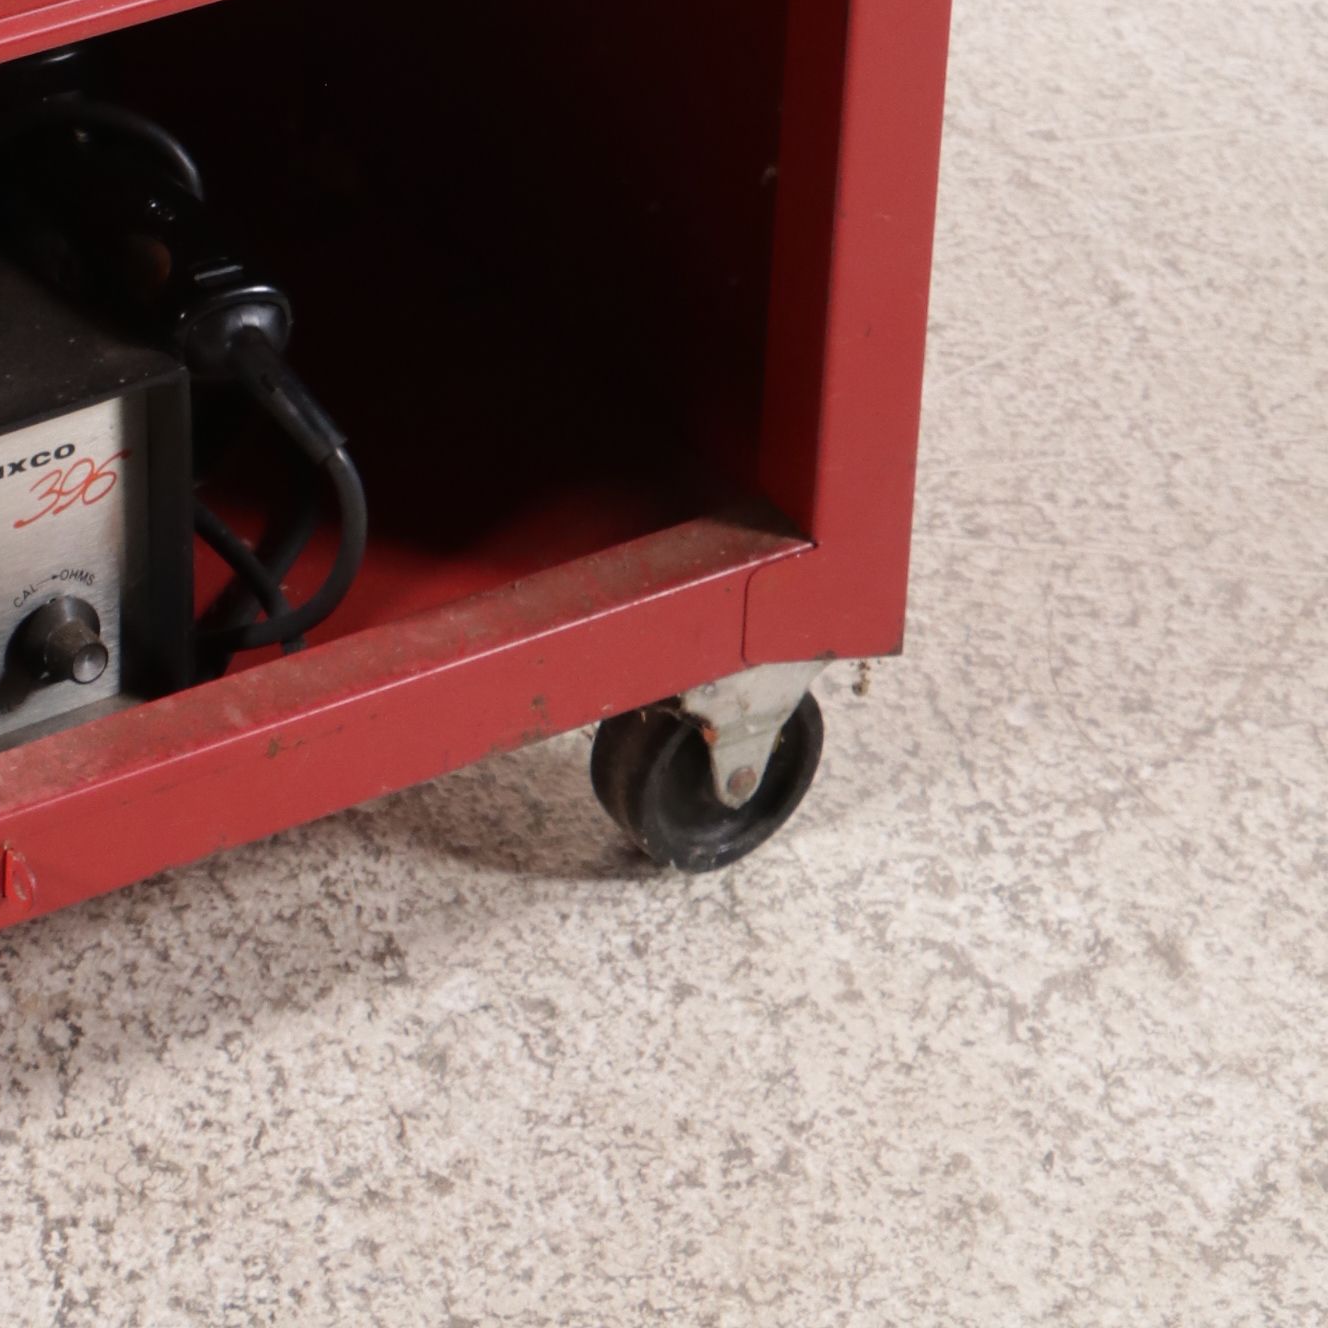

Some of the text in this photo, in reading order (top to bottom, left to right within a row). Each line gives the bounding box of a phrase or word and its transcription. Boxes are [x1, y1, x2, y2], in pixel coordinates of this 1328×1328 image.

[13, 449, 131, 529] 396
[13, 569, 96, 608] CAL OHMS
